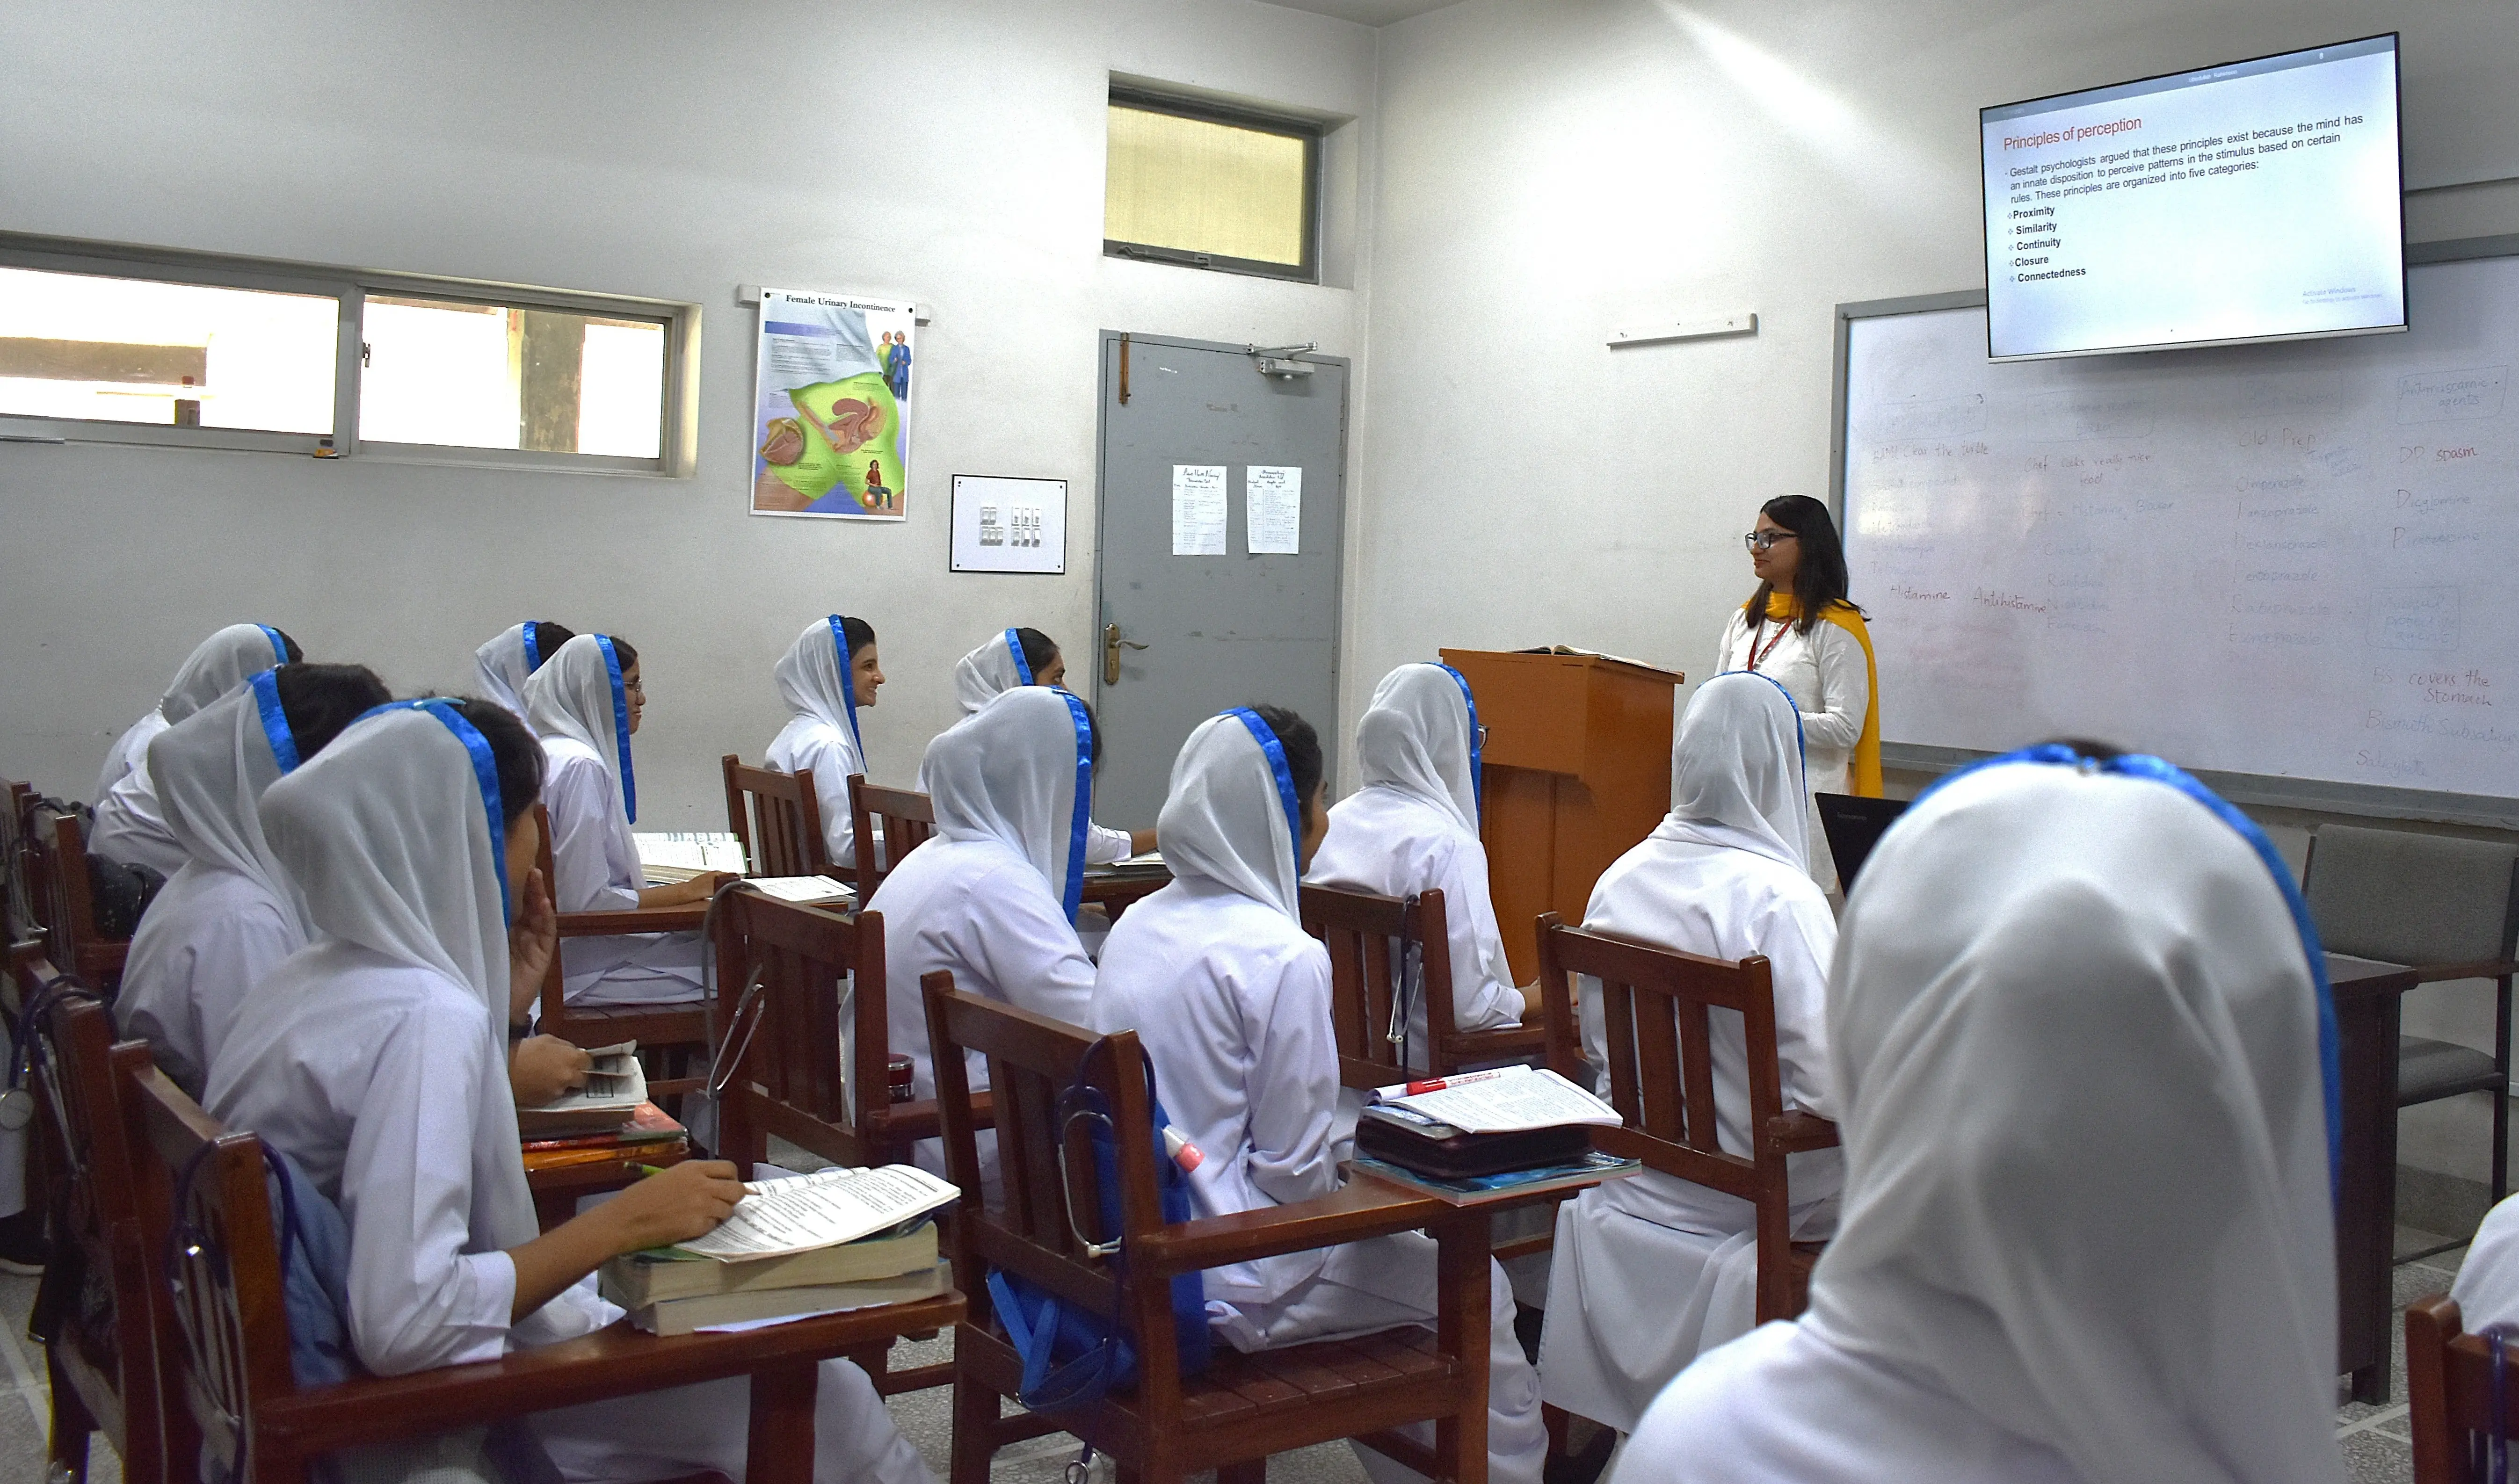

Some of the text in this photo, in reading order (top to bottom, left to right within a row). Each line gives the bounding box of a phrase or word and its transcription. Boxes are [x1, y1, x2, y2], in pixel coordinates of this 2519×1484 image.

[2004, 117, 2142, 150] Principles of perception
[2010, 115, 2363, 177] Gestalt psychologists argued that these principles exist because the mind has
[2011, 133, 2340, 190] an innate disposition to perceive patterns in the stimulus based on certain
[2011, 160, 2259, 204] rules. These principles are organized into five categories:
[2013, 206, 2055, 219] Proximity
[2016, 222, 2057, 234] Similarity
[2017, 238, 2061, 250] Continuity
[2015, 257, 2049, 267] Closure
[2018, 268, 2086, 282] Connectedness
[786, 294, 896, 312] Female Urinary Incontinence
[1935, 442, 1952, 456] the
[1890, 585, 2047, 613] Histamine Antihistamine
[2409, 672, 2456, 686] covers
[2465, 669, 2490, 687] the
